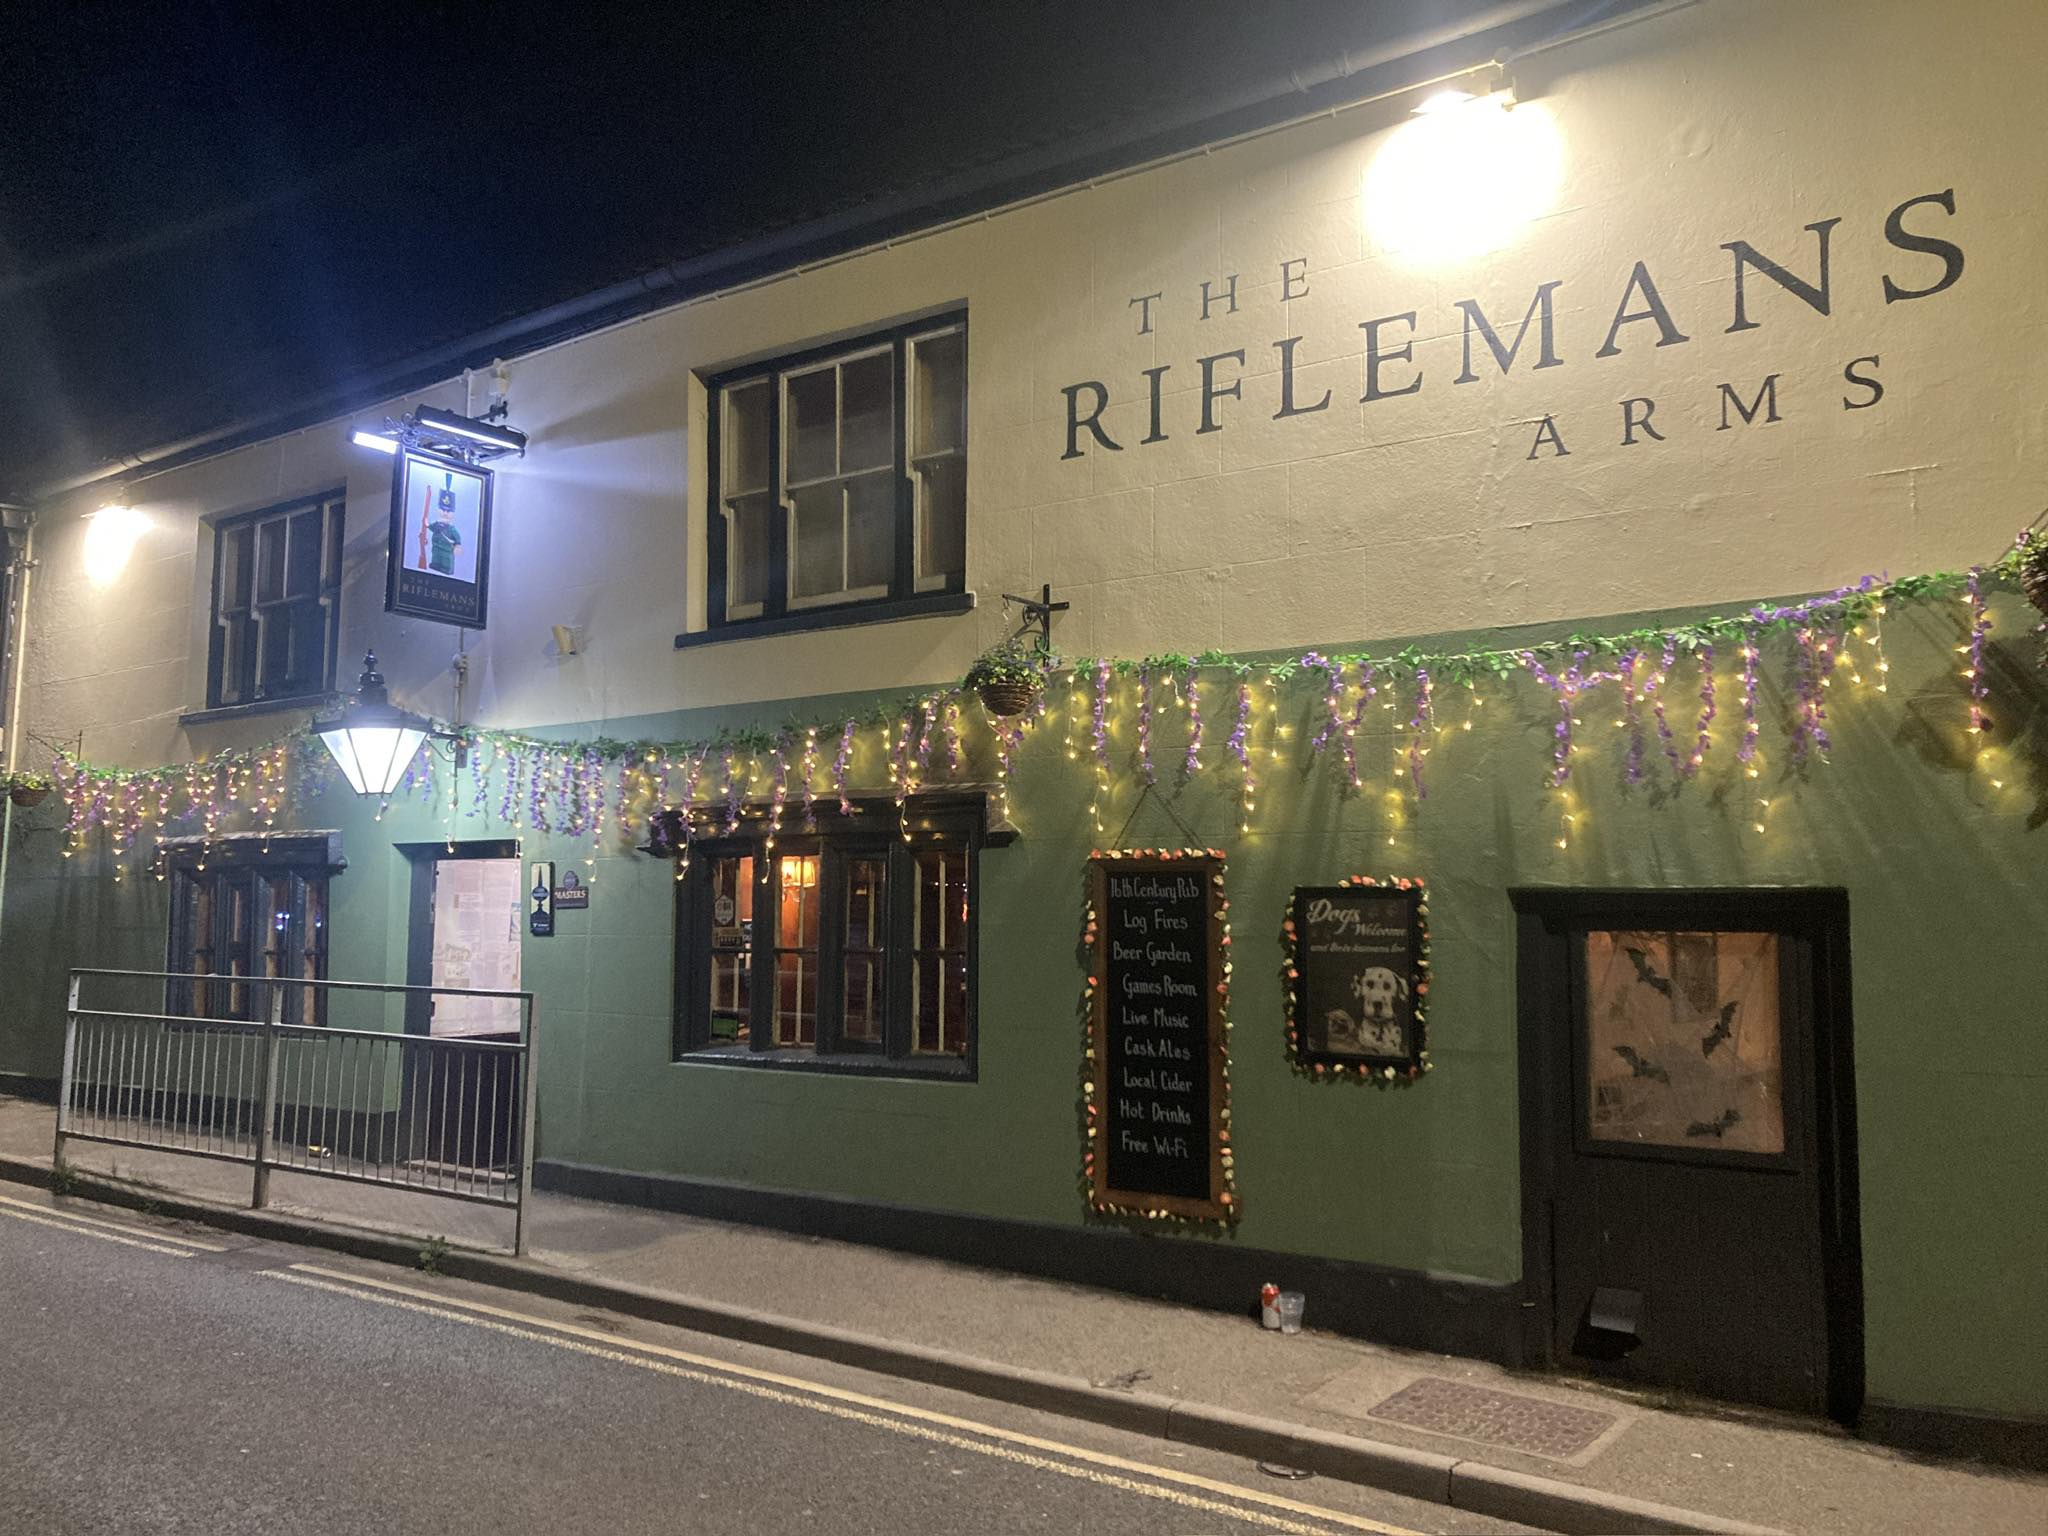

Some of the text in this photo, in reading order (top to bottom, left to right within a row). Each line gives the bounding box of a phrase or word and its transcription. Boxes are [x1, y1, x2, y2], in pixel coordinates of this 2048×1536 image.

[1129, 258, 1310, 334] THE
[1060, 189, 1966, 460] RIFLEMANS
[1526, 355, 1886, 460] ARMS
[402, 583, 475, 606] RIFLEMANS
[1111, 878, 1199, 903] 16th Century Pub
[1124, 909, 1188, 934] Log Fires
[1306, 898, 1361, 935] Dogs
[1113, 941, 1192, 967] Beer Garden
[1122, 974, 1197, 999] Games Room
[1123, 1006, 1189, 1028] Live Music
[1124, 1036, 1191, 1061] Cask Ales
[1124, 1067, 1193, 1092] Local Cider
[1120, 1098, 1191, 1125] Hot Drinks
[1122, 1130, 1149, 1153] Free
